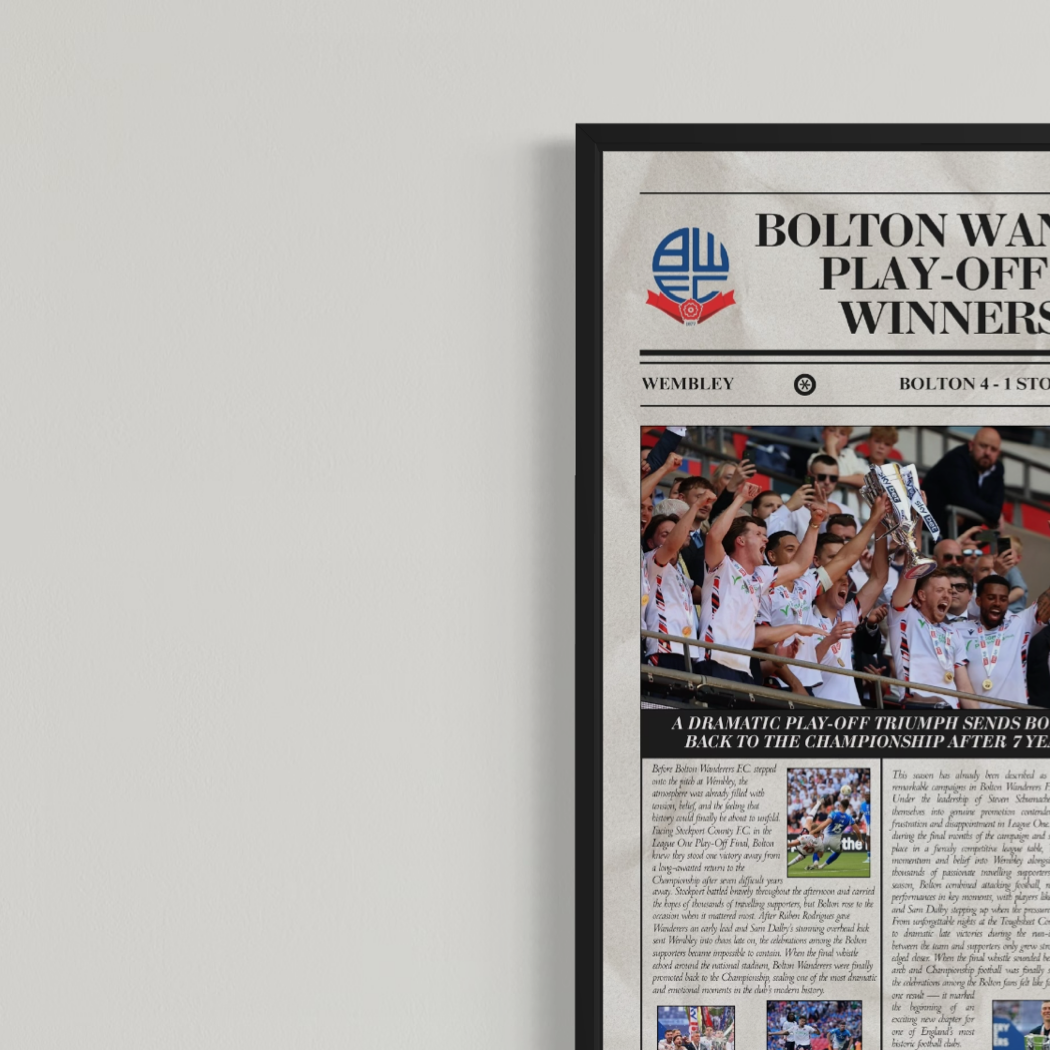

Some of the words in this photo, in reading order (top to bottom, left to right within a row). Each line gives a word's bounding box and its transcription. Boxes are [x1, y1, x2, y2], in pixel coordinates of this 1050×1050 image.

[755, 213, 948, 247] BOLTON
[820, 256, 1048, 291] PLAY-OFF
[642, 378, 733, 390] WEMBLEY
[900, 378, 975, 390] BOLTON
[980, 377, 988, 390] 4
[1005, 378, 1010, 390] 1
[878, 471, 891, 486] sky
[914, 500, 928, 515] sky
[924, 514, 939, 533] bet
[672, 717, 682, 729] A
[689, 717, 780, 730] DRAMATIC
[786, 717, 870, 729] PLAY-OFF
[876, 717, 958, 730] TRIUMPH
[963, 717, 1021, 729] SENDS
[685, 735, 733, 748] BACK
[737, 735, 759, 748] TO
[765, 735, 800, 748] THE
[805, 735, 944, 748] CHAMPIONSHIP
[947, 735, 1006, 748] AFTER
[1014, 735, 1022, 748] 7
[652, 764, 673, 776] Before
[675, 764, 697, 774] Bolton
[700, 764, 734, 774] Wanderers
[754, 764, 777, 776] stepped
[652, 839, 675, 851] League
[677, 839, 692, 848] One
[695, 839, 728, 851] Play-Off
[752, 839, 774, 848] Bolton
[842, 837, 862, 850] the
